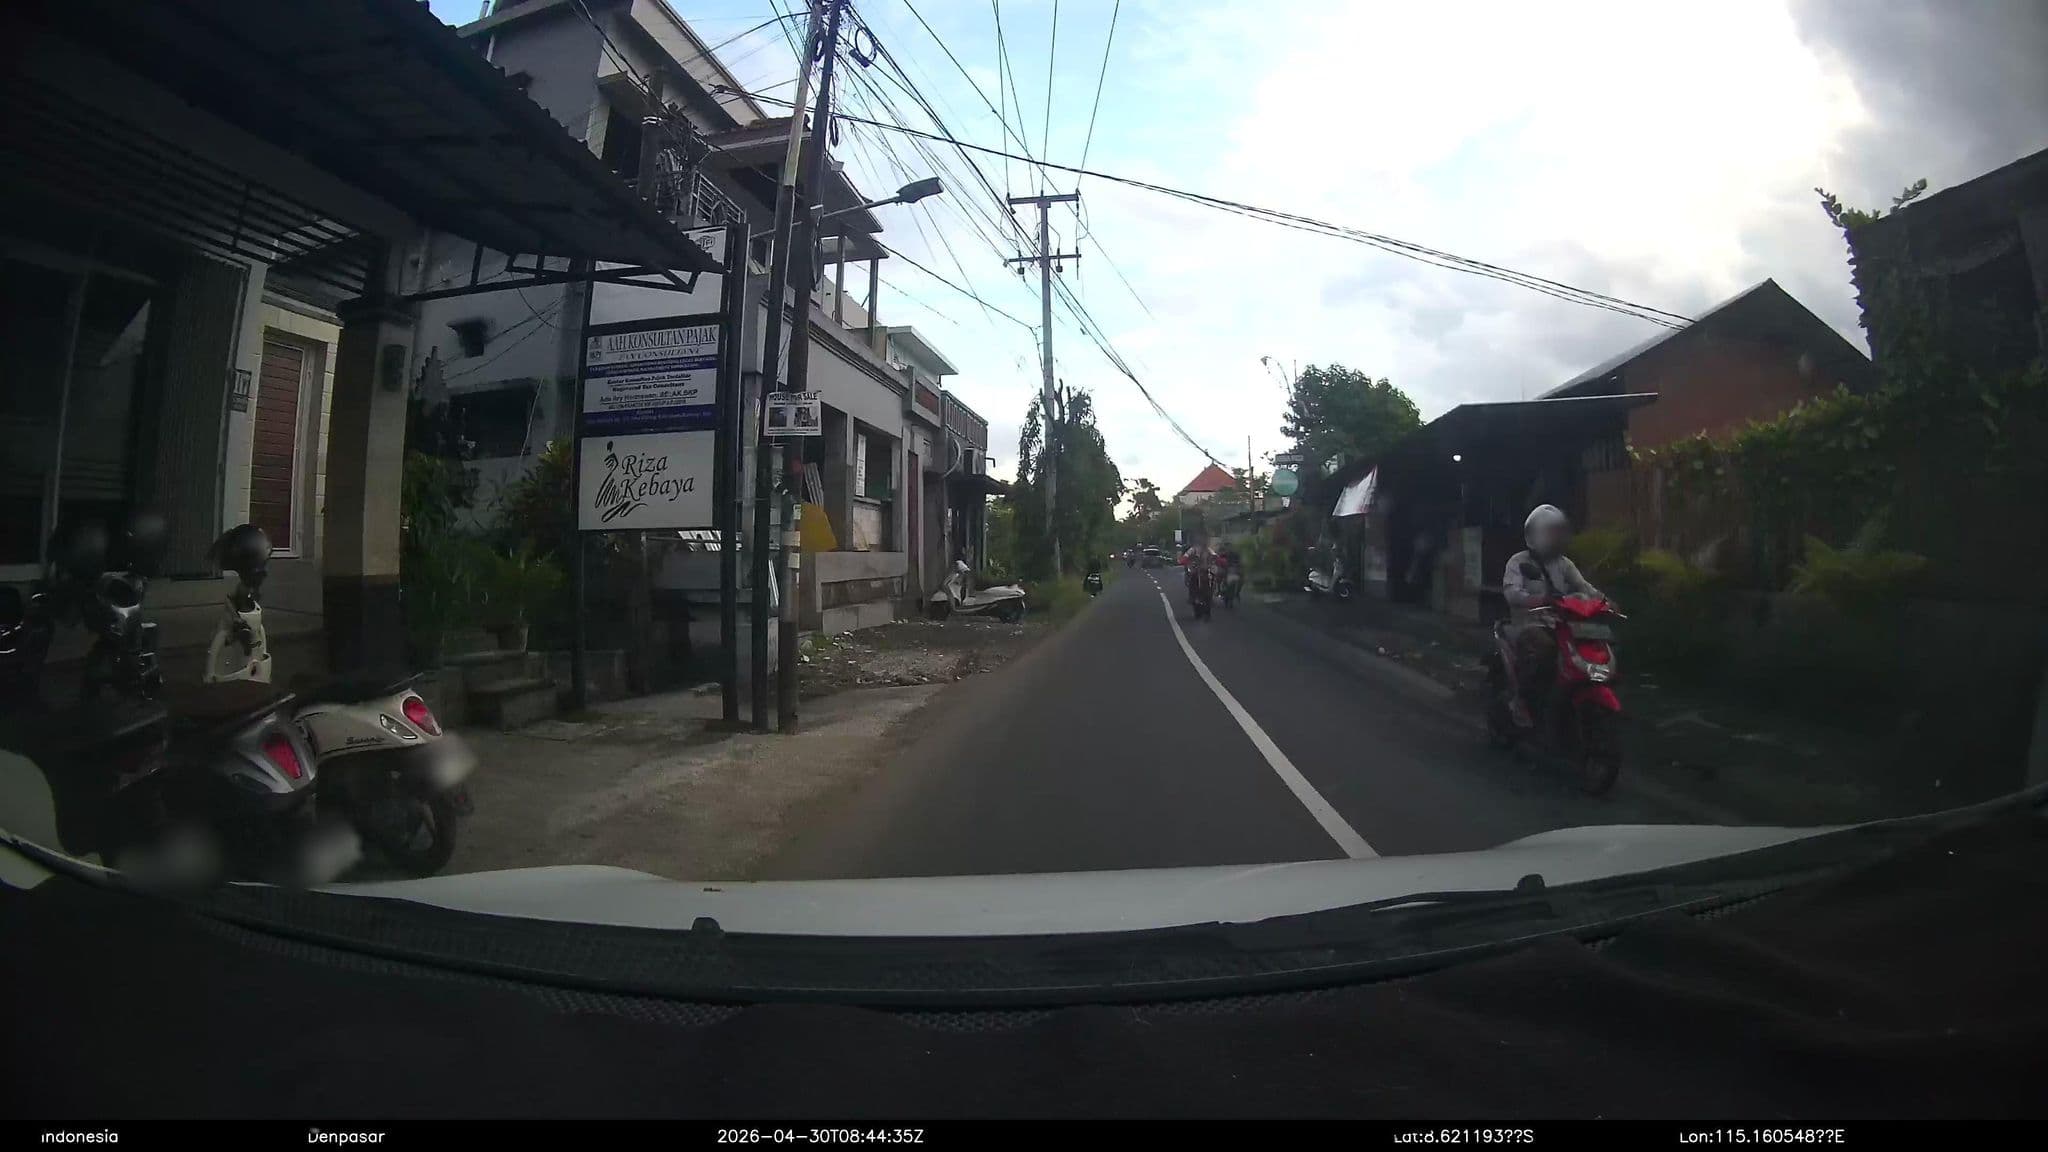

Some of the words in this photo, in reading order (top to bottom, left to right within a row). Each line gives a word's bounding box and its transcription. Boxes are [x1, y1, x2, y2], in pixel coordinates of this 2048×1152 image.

[608, 334, 627, 351] AAH
[627, 329, 684, 349] KONSULTAN
[687, 326, 717, 345] PAJAK
[621, 453, 668, 478] Riza
[620, 472, 694, 501] Kebaya
